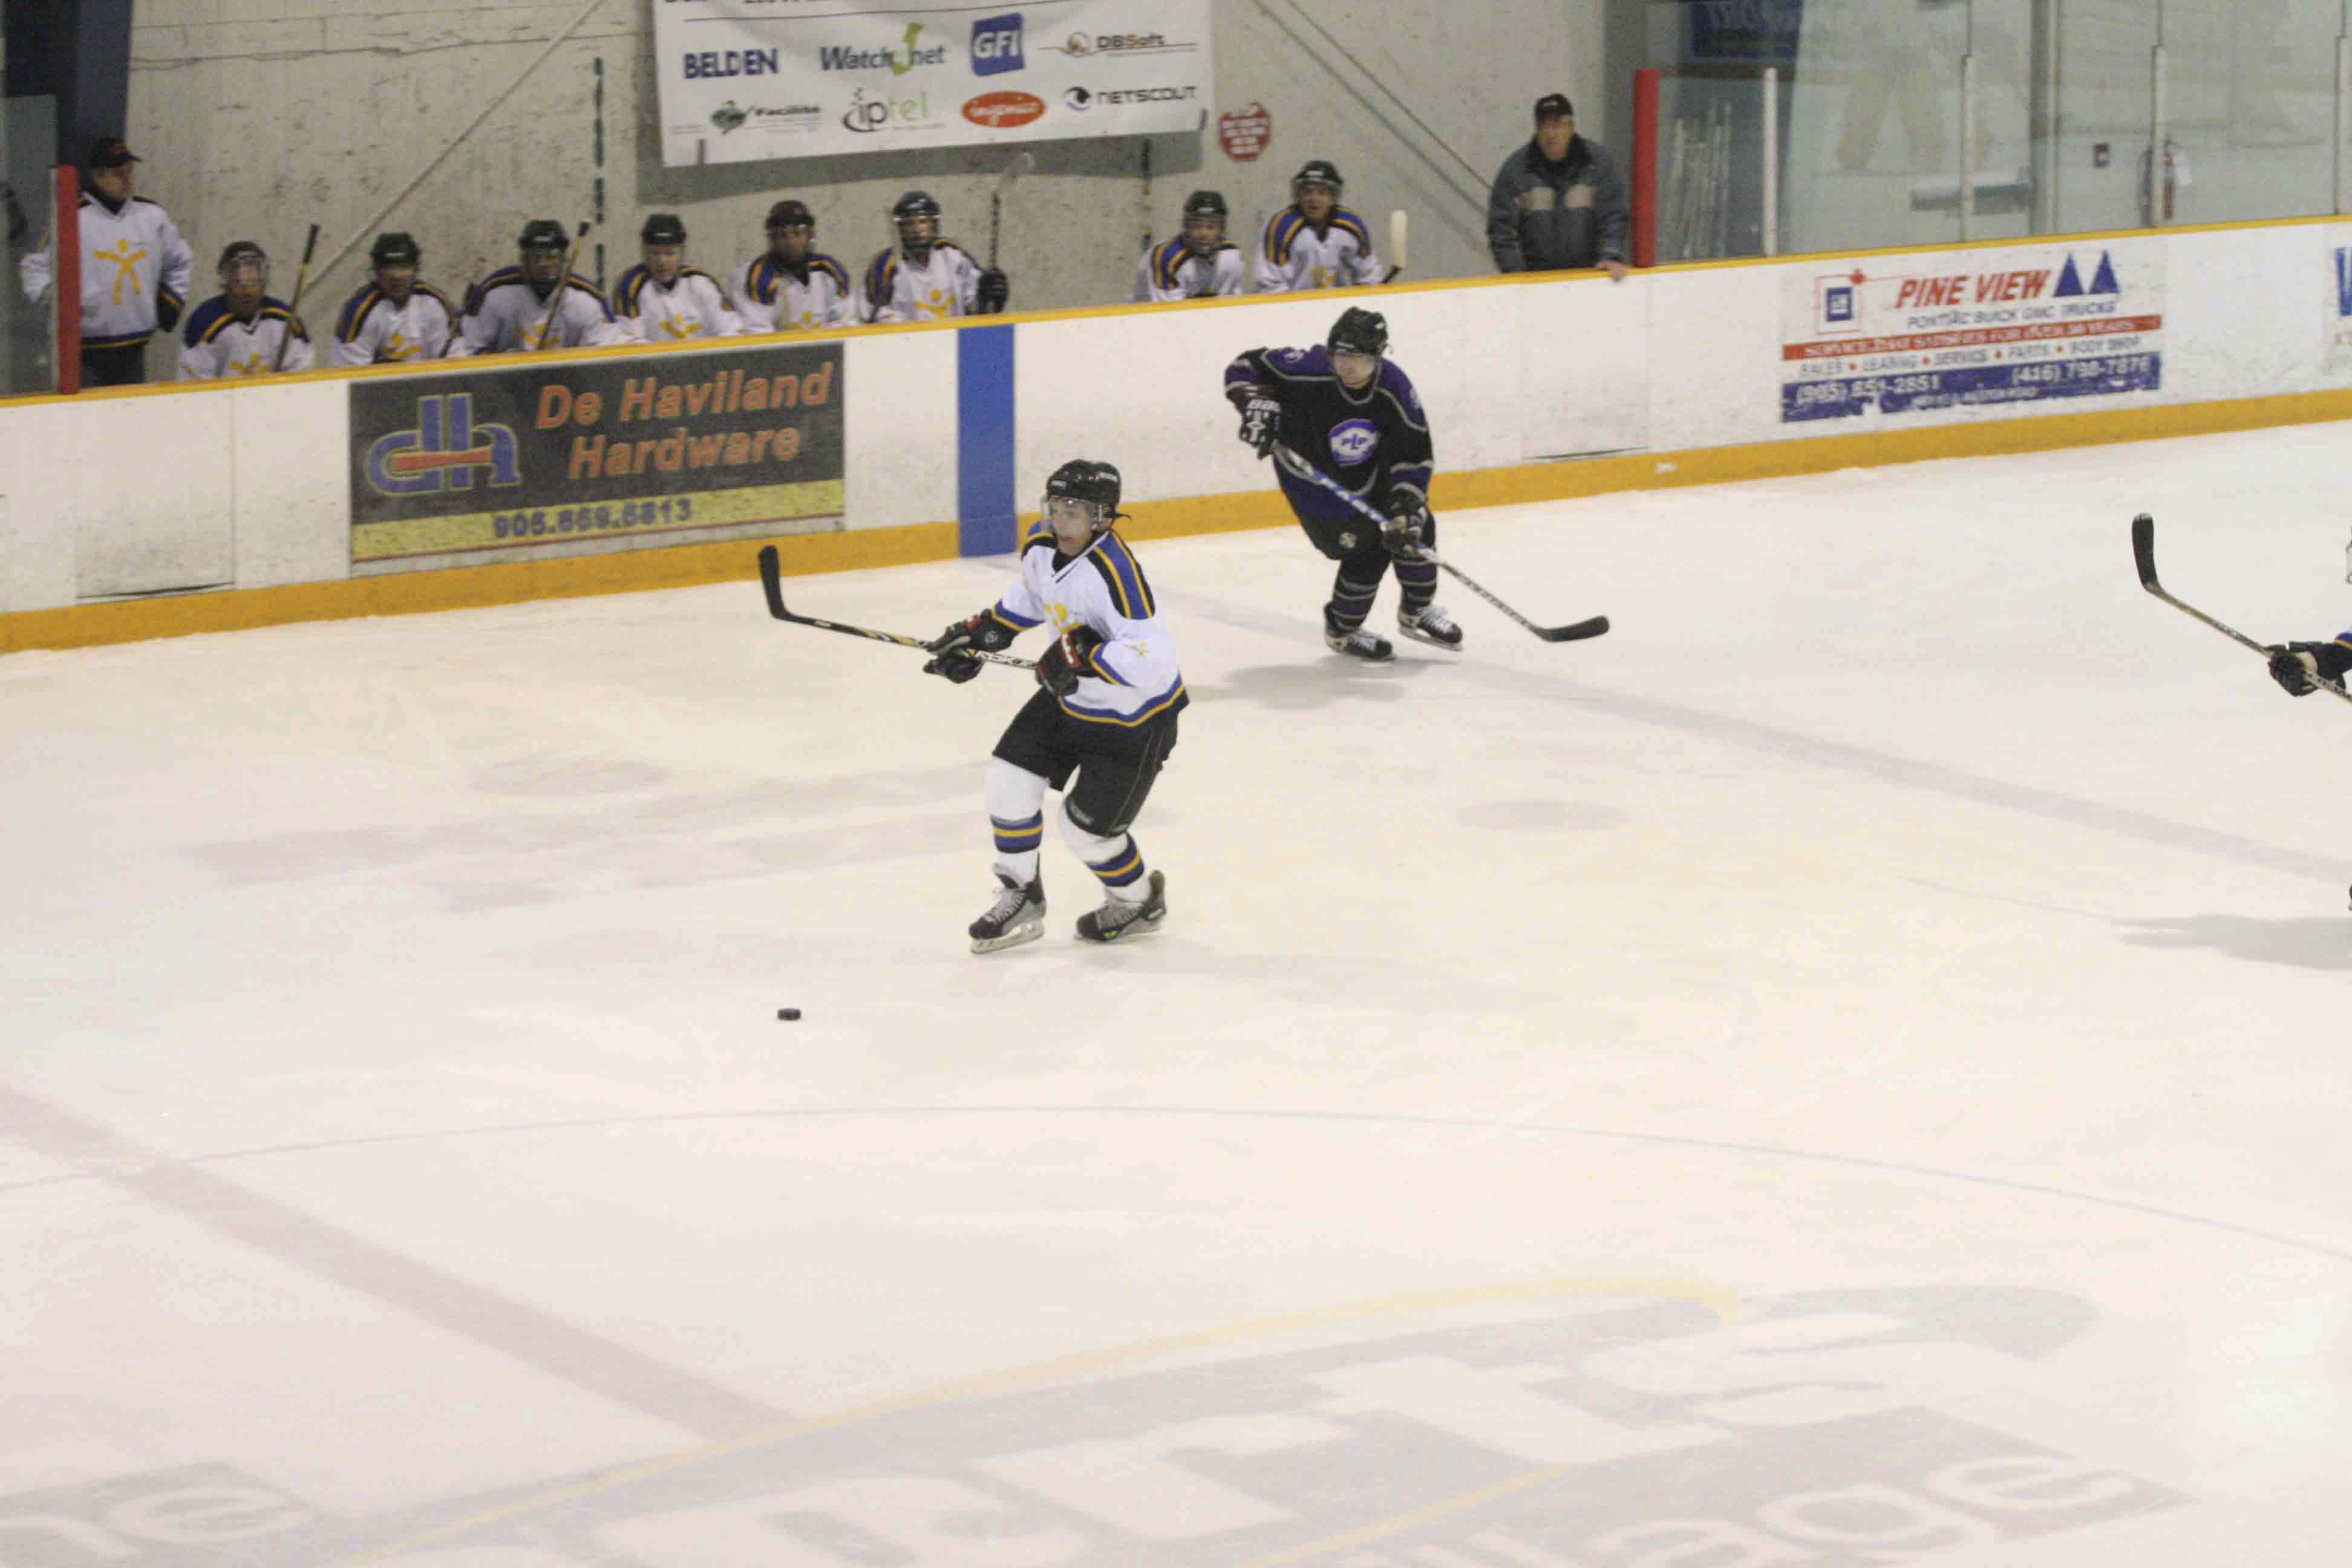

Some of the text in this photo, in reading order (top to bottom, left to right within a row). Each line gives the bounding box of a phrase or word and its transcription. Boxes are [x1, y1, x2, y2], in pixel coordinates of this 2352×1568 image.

[973, 30, 1021, 59] GFI
[684, 48, 778, 79] BELDEN
[1895, 269, 2052, 310] PINE VIEW
[1974, 308, 2016, 324] BUICK
[2012, 364, 2062, 384] (416)
[536, 362, 834, 430] De Haviland
[568, 426, 801, 480] Hardware
